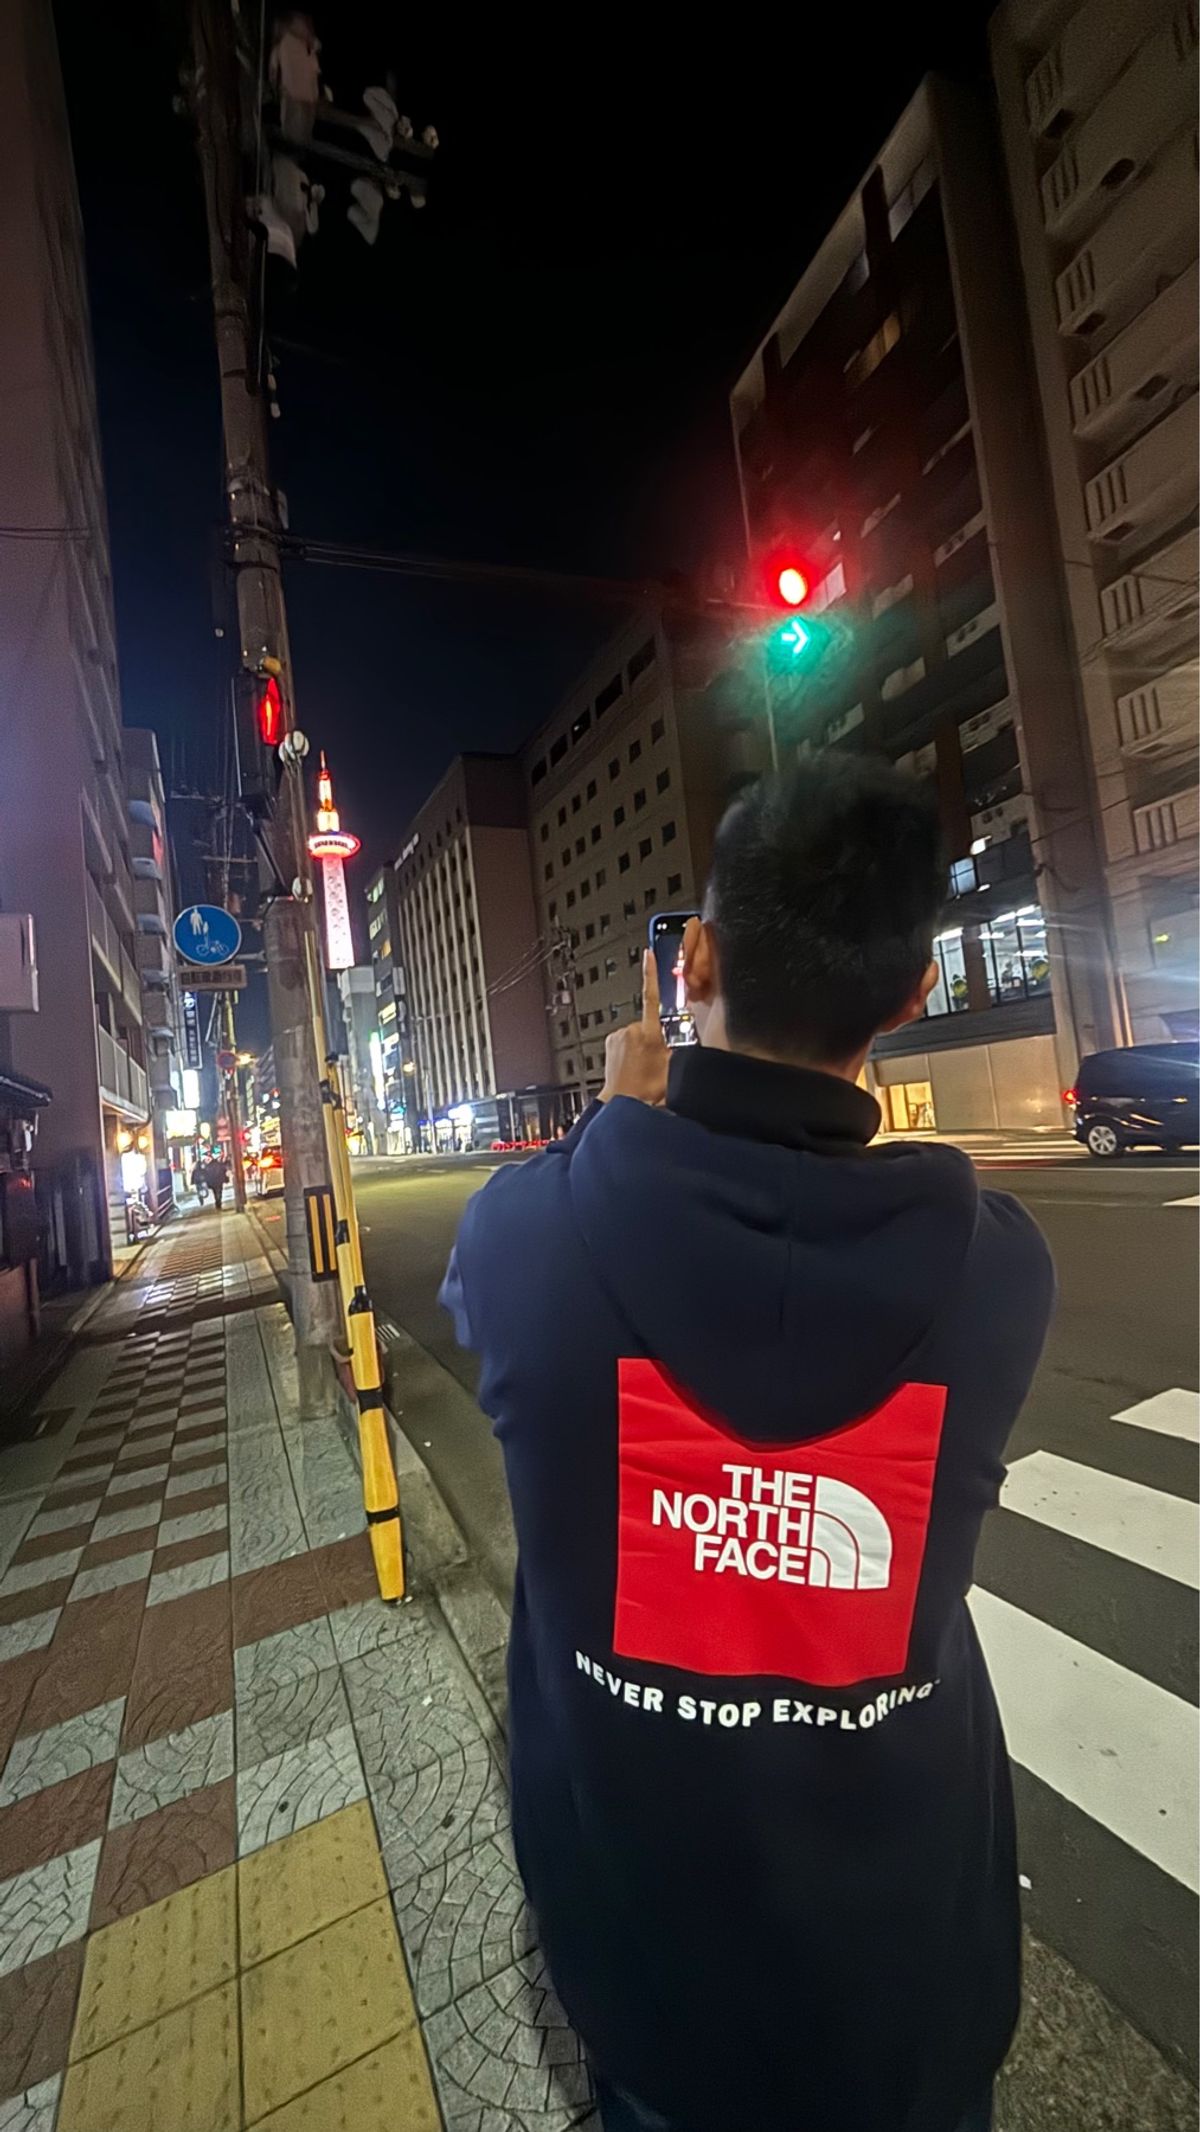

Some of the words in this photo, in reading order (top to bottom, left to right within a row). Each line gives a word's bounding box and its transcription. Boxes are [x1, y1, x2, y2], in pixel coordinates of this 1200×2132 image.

[721, 1463, 814, 1511] THE
[651, 1488, 811, 1548] NORTH
[694, 1532, 808, 1585] FACE
[575, 1650, 664, 1713] NEVER
[677, 1695, 762, 1728] STOP
[772, 1682, 934, 1731] EXPLORING
